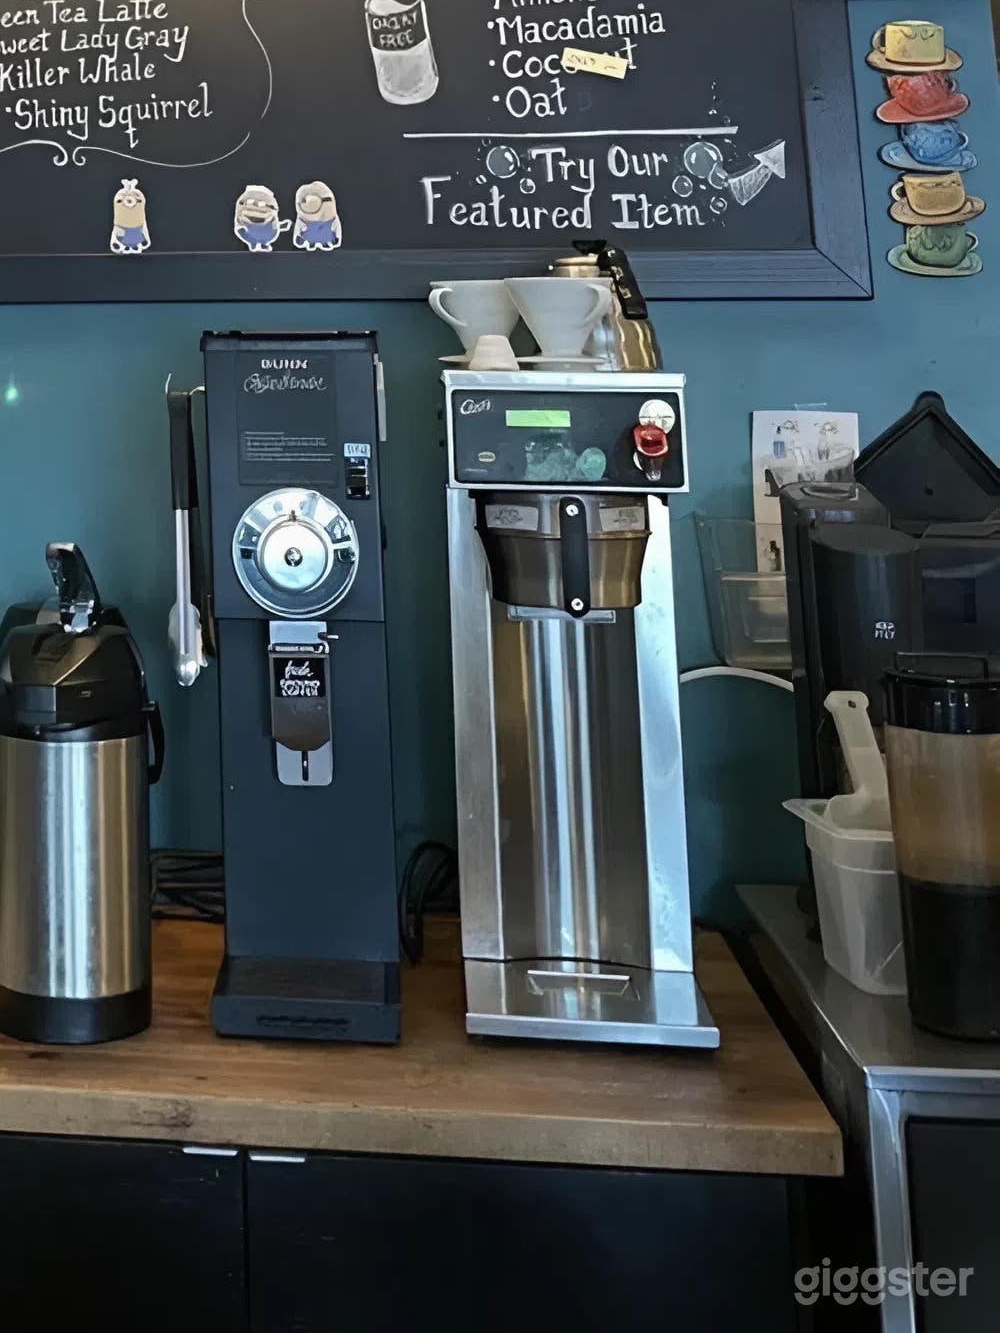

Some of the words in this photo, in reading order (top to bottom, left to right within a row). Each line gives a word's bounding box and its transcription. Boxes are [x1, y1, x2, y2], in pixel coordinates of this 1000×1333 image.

[44, 0, 88, 25] Tea
[498, 3, 666, 45] Macadamia
[60, 24, 118, 59] Lady
[124, 24, 190, 63] Gray
[79, 53, 156, 83] Whale
[14, 98, 89, 140] Shiny
[98, 82, 213, 149] Squirrel
[505, 79, 568, 118] Oat
[529, 146, 595, 192] Try
[608, 145, 668, 177] Our
[421, 176, 592, 229] Featured
[612, 192, 706, 229] Item
